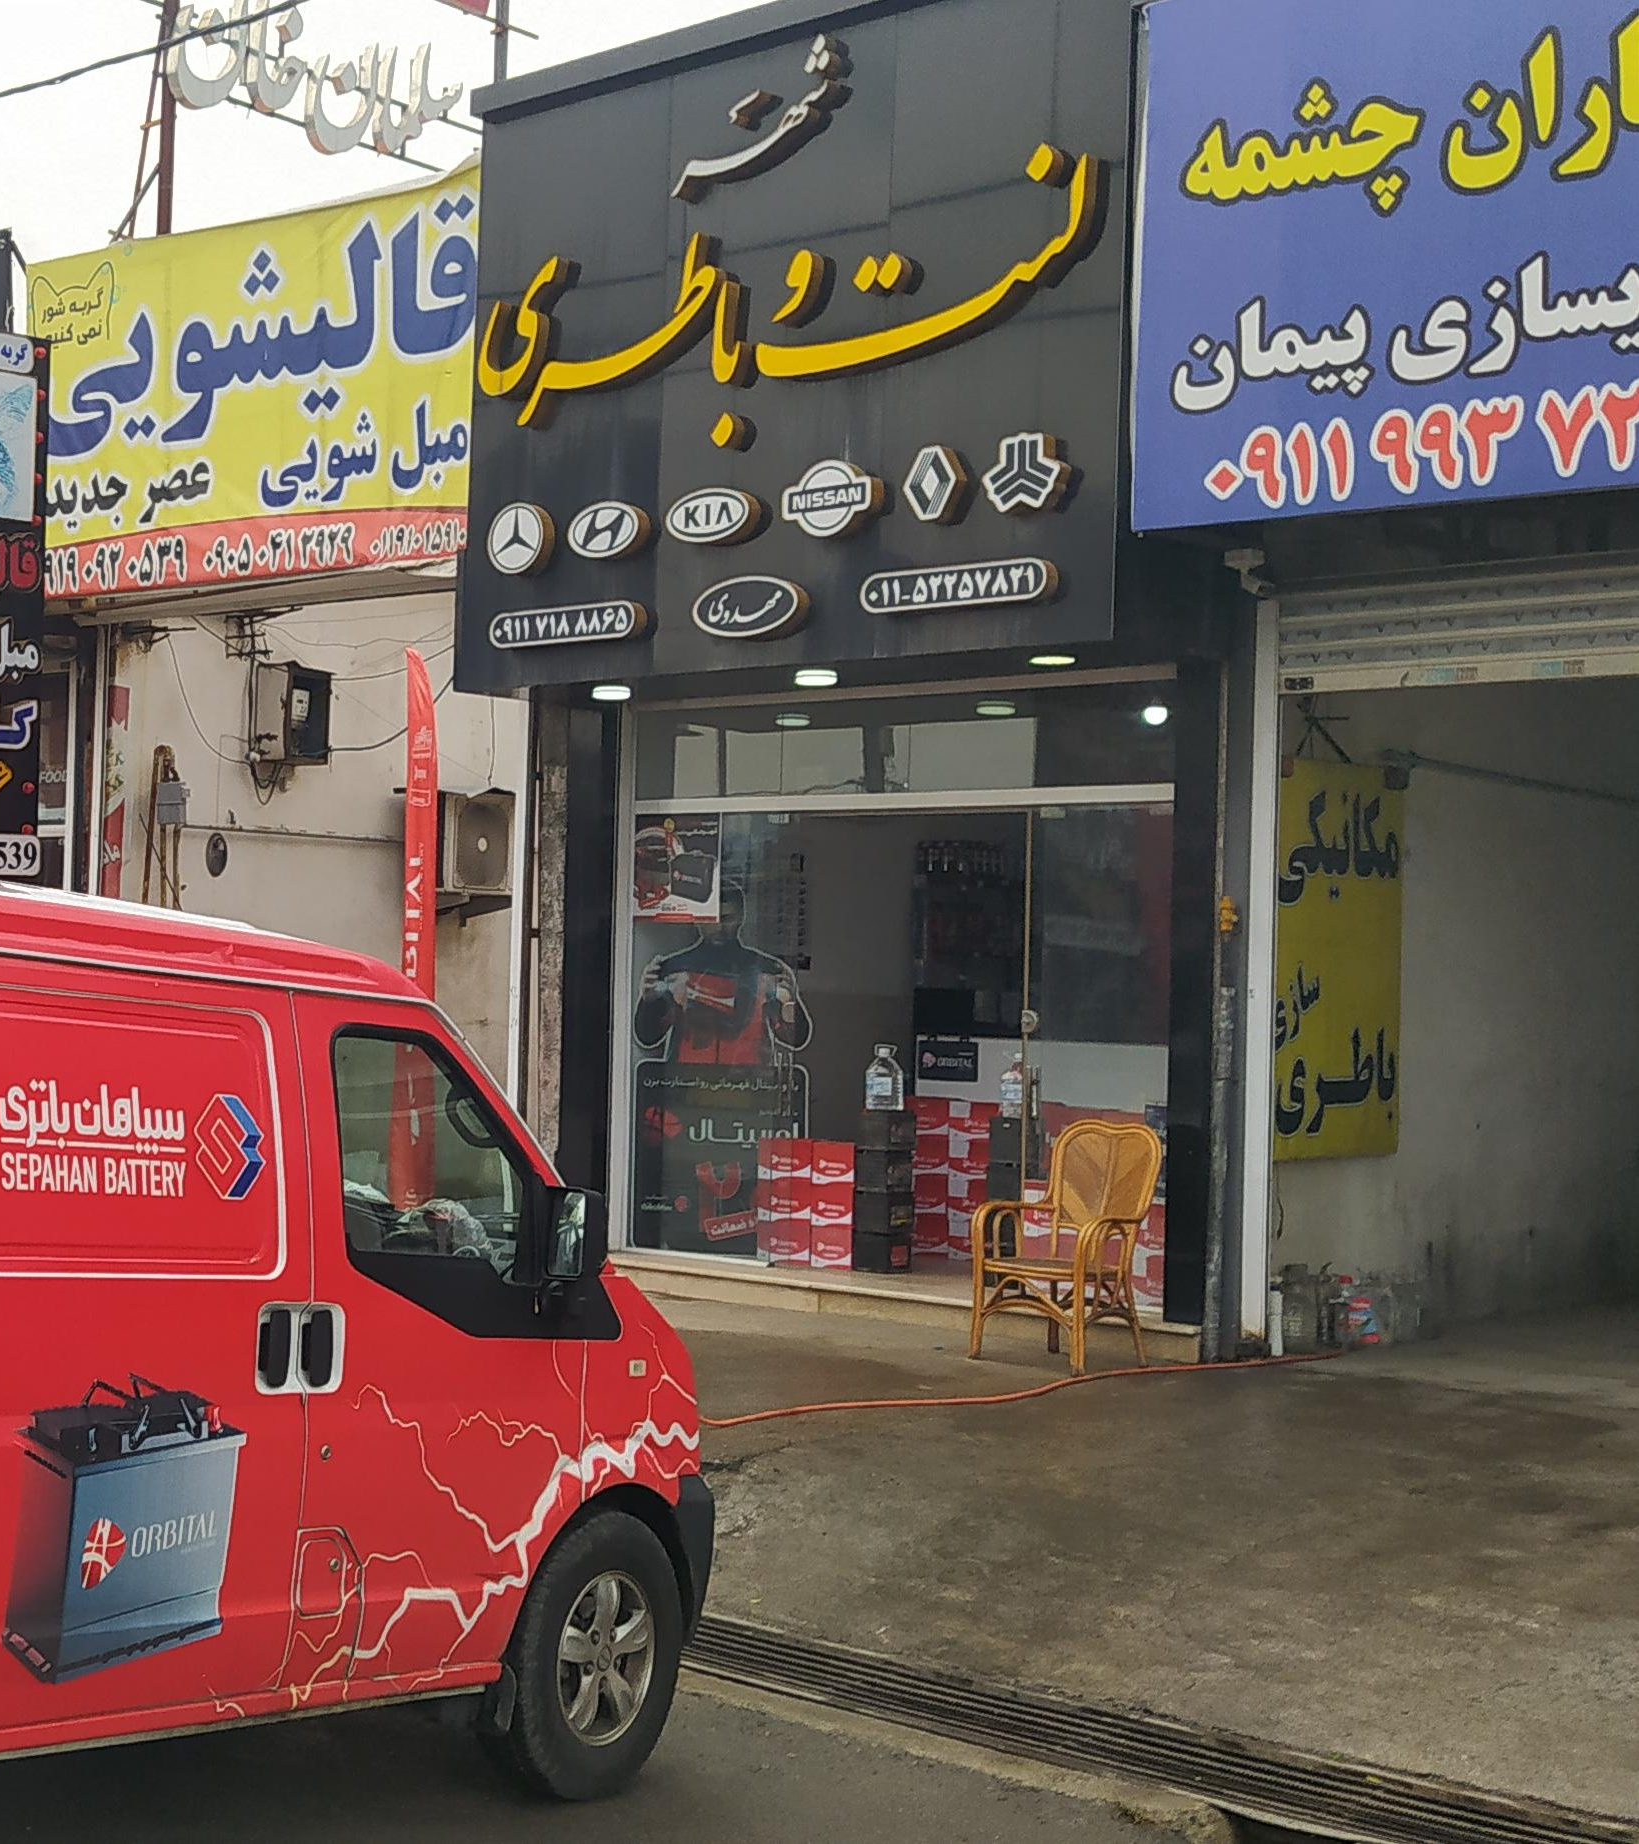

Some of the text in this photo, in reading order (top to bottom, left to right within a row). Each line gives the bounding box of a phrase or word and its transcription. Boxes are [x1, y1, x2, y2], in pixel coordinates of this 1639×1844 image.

[1182, 78, 1423, 216] چشمه
[41, 288, 104, 325] گربه شور
[477, 141, 1097, 446] لنت و باطری
[0, 344, 28, 366] گربه
[48, 193, 477, 458] قالیشویی
[76, 322, 103, 346] نمی
[1172, 297, 1372, 414] پیمان
[260, 398, 468, 507] مبل شویی
[1205, 417, 1355, 508] ۰۹۱۱
[1370, 391, 1523, 493] ۹۹۳
[45, 461, 212, 528] عصر جدید
[683, 504, 734, 530] KIA
[791, 485, 864, 512] NISSAN
[82, 542, 124, 590] ۰۹۲
[126, 534, 188, 586] ۰۵۳۹
[493, 609, 628, 643] ۰۹۱۱ ۷۱۸ ۸۸۶۵
[707, 589, 783, 626] مهدوی
[1277, 787, 1400, 905] مکانیکی
[1275, 1027, 1397, 1139] باطری
[74, 1083, 186, 1155] سپاهان
[0, 1151, 187, 1198] SEPAHAN BATTERY
[131, 1509, 218, 1559] ORBITAL
